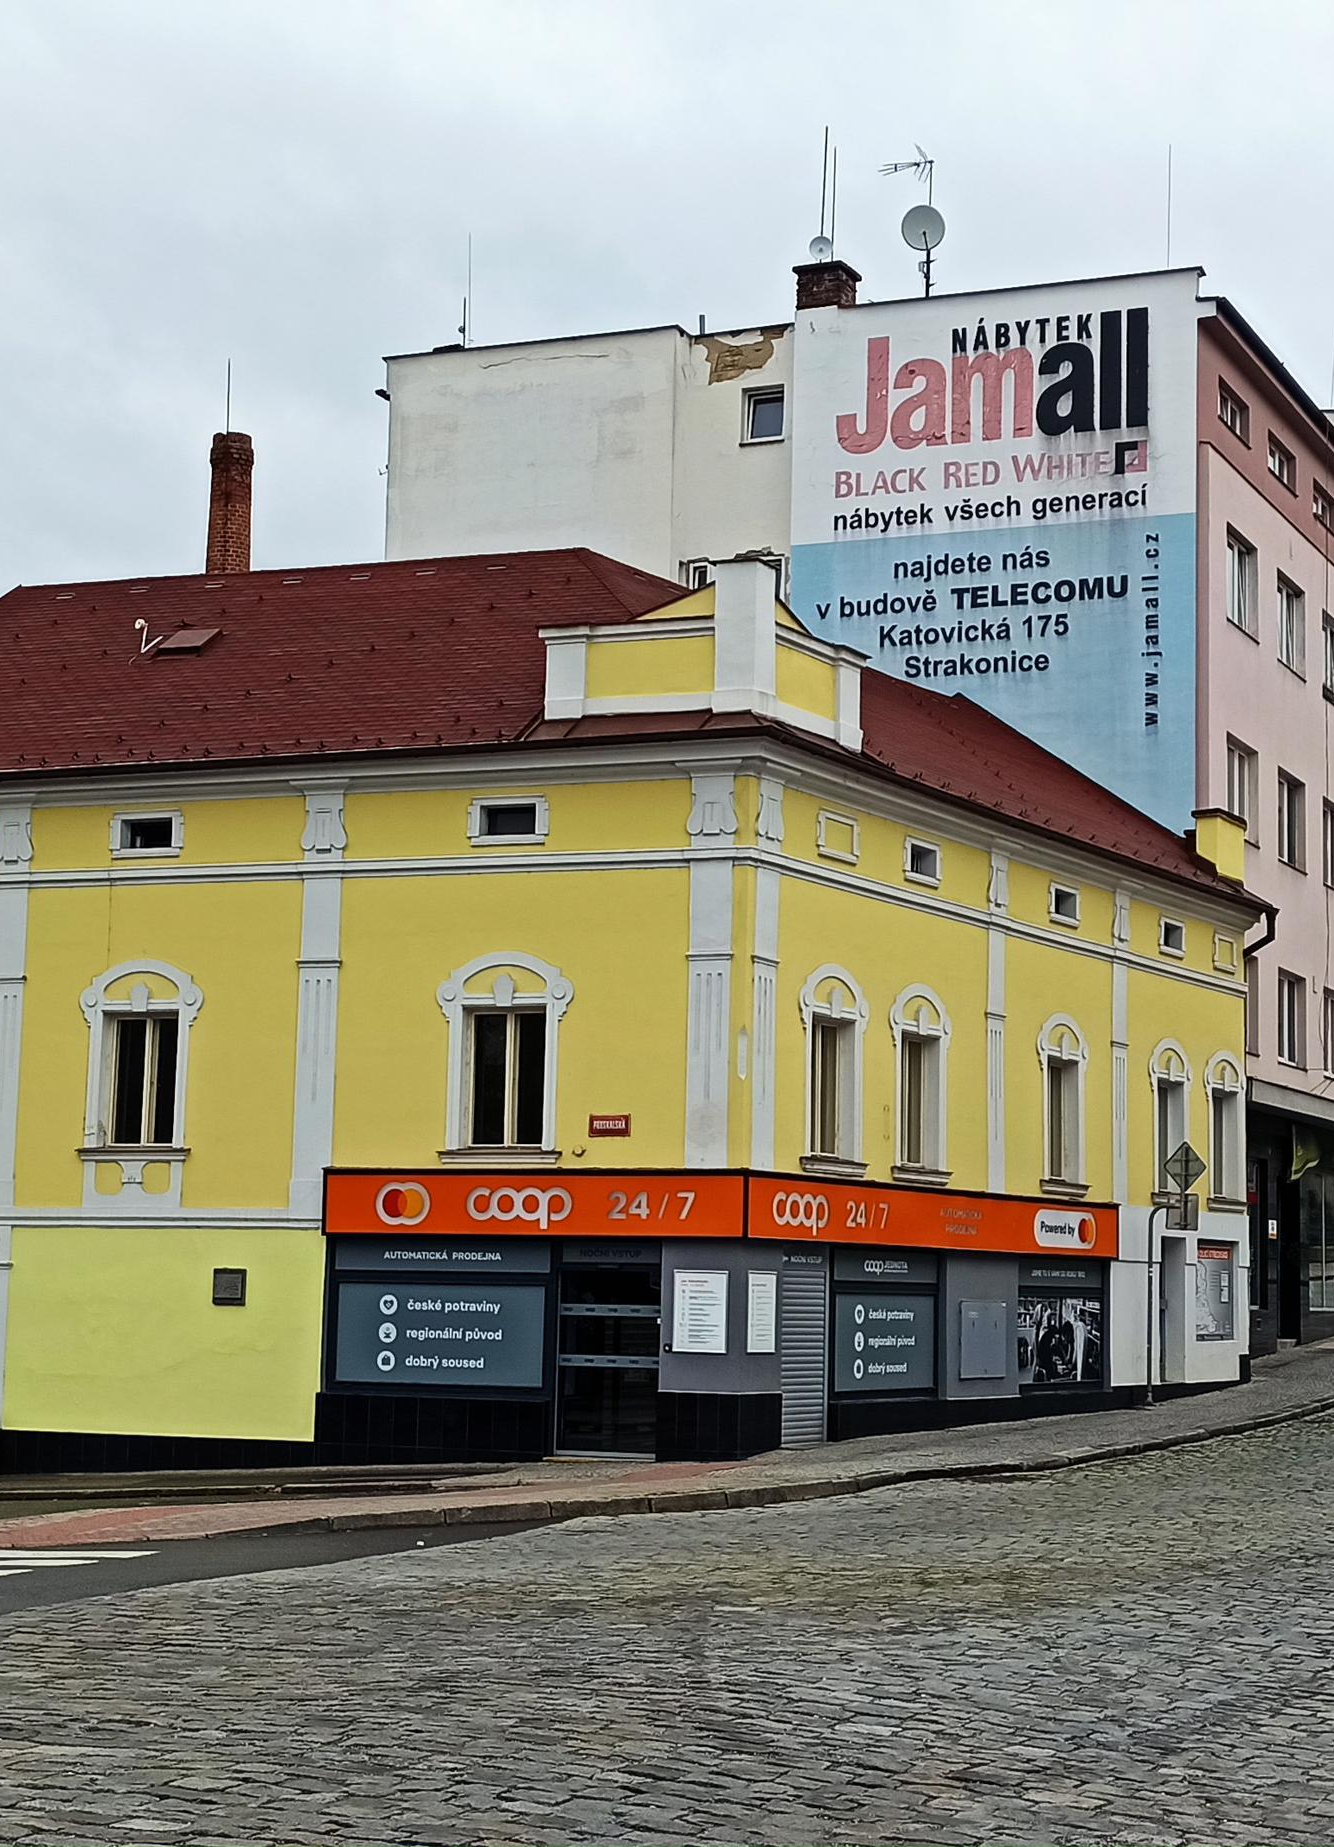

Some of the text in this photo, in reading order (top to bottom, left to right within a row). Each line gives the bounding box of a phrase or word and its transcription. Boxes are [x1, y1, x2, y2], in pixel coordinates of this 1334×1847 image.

[952, 313, 1094, 354] NÁBYTEK
[835, 307, 1149, 455] Jamall
[834, 466, 927, 499] BLACK
[943, 459, 1001, 490] RED
[833, 483, 1149, 534] nábytek všech generací
[893, 546, 1051, 582] najdete nás
[816, 574, 1129, 620] v budově TELECOMU
[879, 613, 1070, 649] Katovická 175
[1141, 533, 1164, 727] www.jamall.cz
[904, 652, 1051, 679] Strakonice
[467, 1187, 573, 1230] coop
[772, 1191, 829, 1236] coop
[1040, 1220, 1076, 1237] Powered by
[384, 1250, 502, 1261] AUTOMATICKÁ PRODEJNA
[407, 1299, 500, 1314] české potraviny
[406, 1327, 503, 1341] regionální původ
[405, 1355, 484, 1369] dobrý soused
